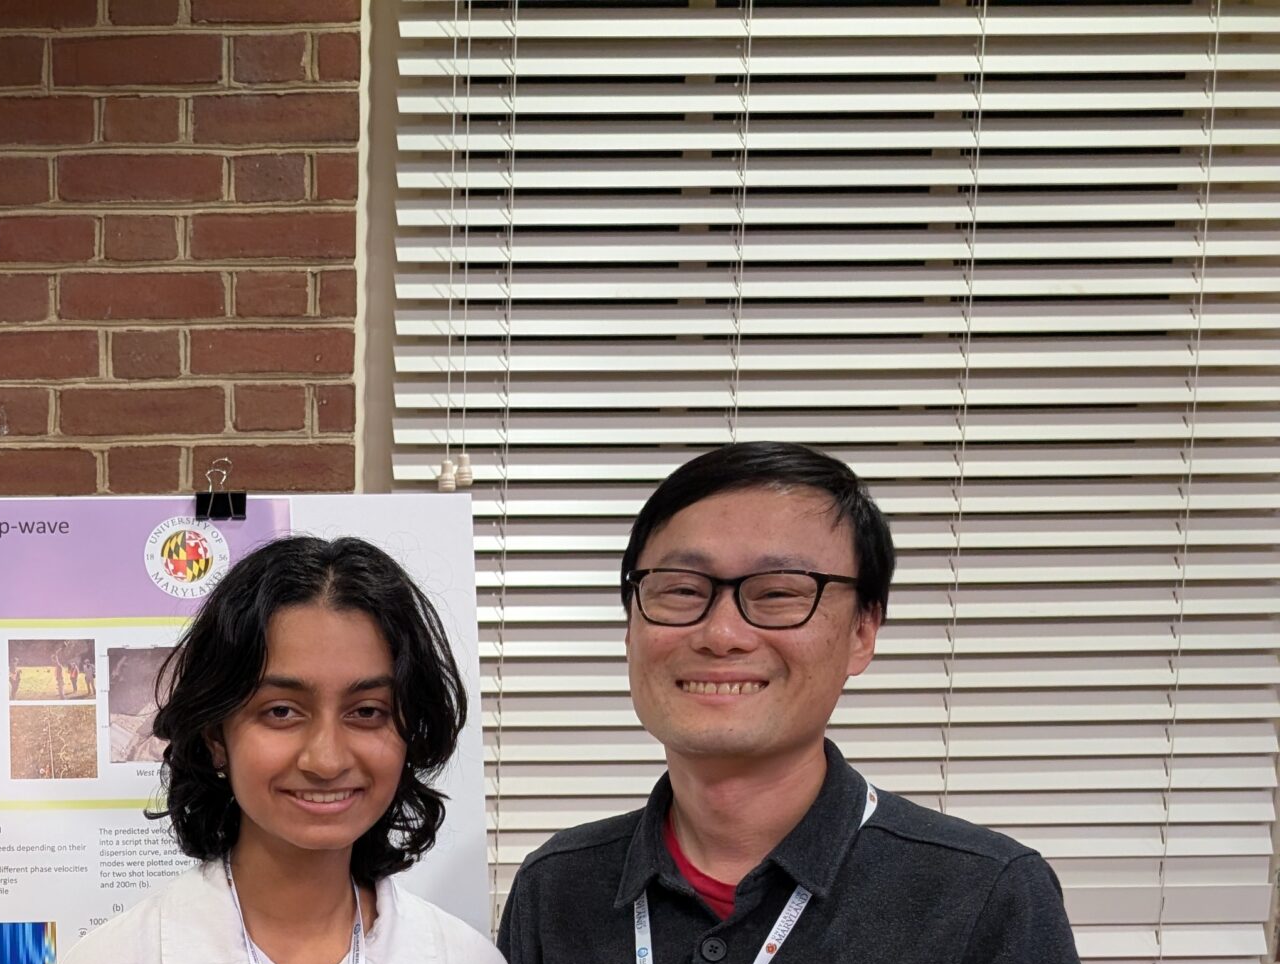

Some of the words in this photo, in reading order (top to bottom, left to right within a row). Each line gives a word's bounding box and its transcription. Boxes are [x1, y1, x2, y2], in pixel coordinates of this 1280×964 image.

[150, 517, 210, 544] UNIVERSITY
[211, 531, 223, 544] OF
[152, 571, 222, 597] MARYLAND
[776, 893, 808, 944] MARYLAND
